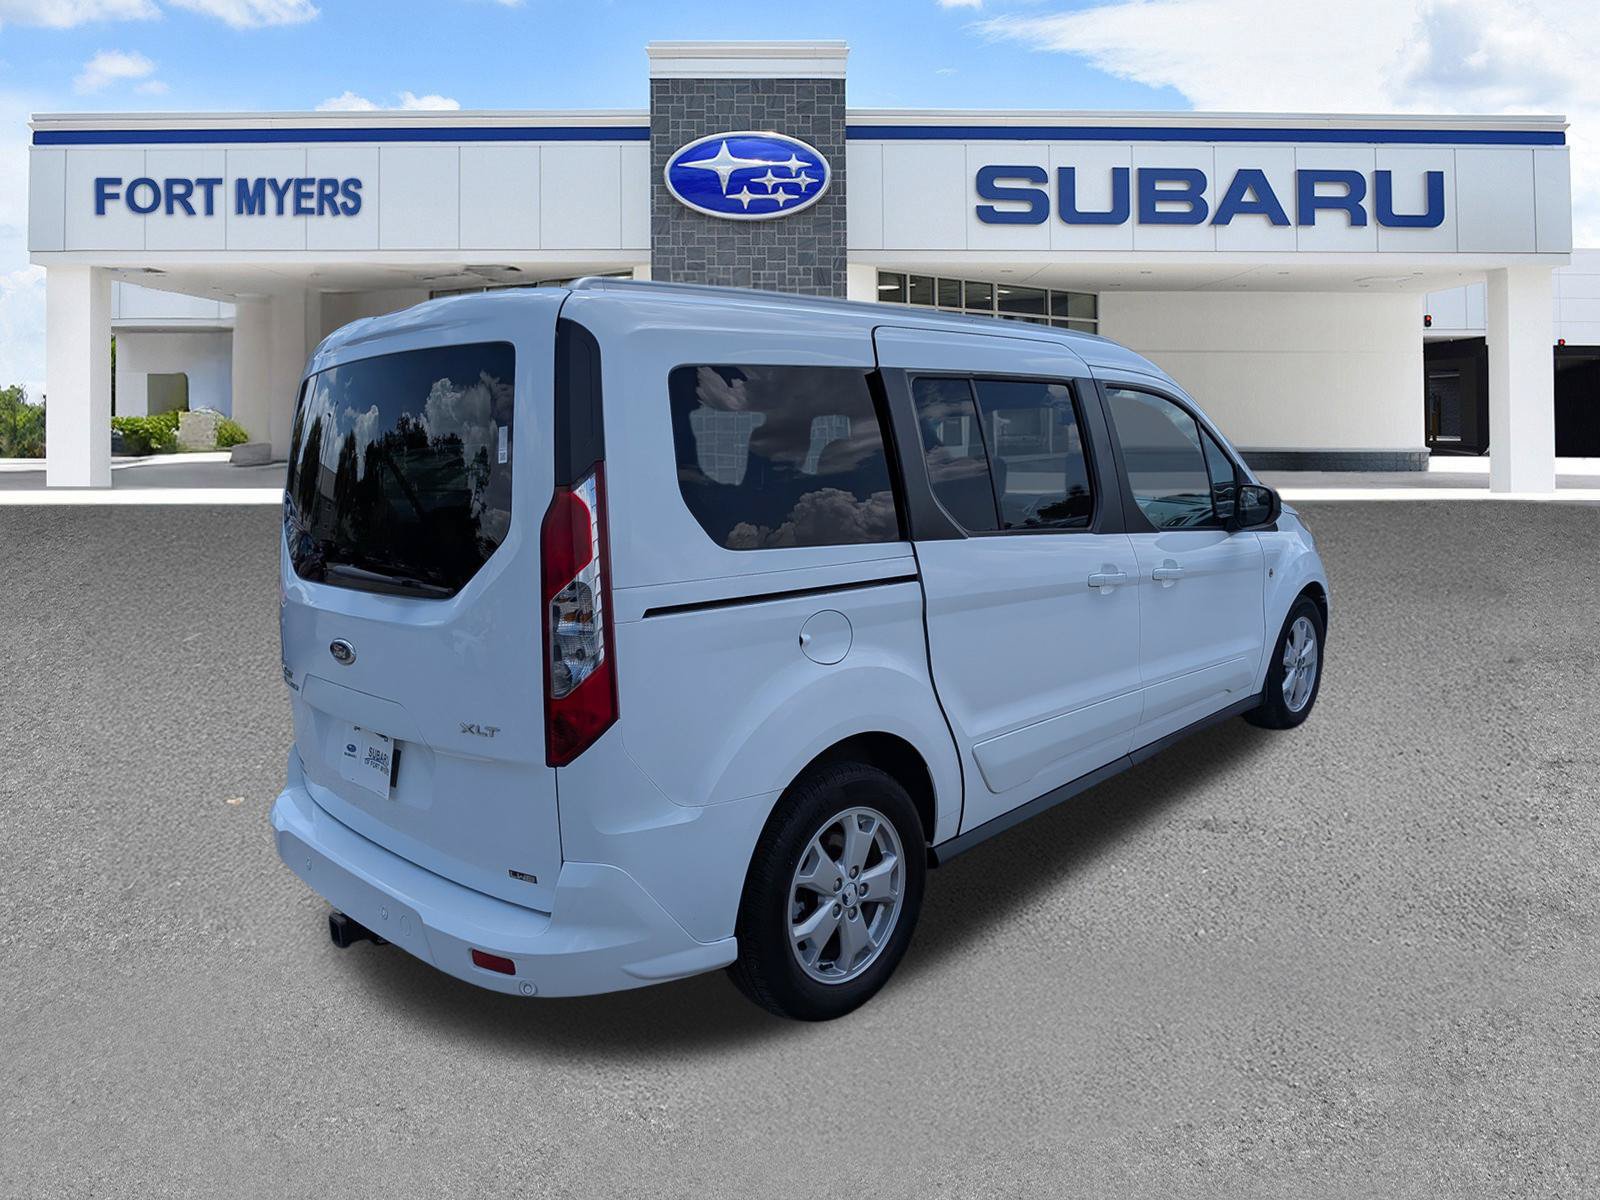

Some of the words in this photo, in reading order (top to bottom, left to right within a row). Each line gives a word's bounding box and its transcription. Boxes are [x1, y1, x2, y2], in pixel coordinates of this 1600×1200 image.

[94, 177, 223, 216] FORT
[235, 177, 363, 216] MYERS
[975, 165, 1445, 228] SUBARU
[460, 722, 501, 738] XLT
